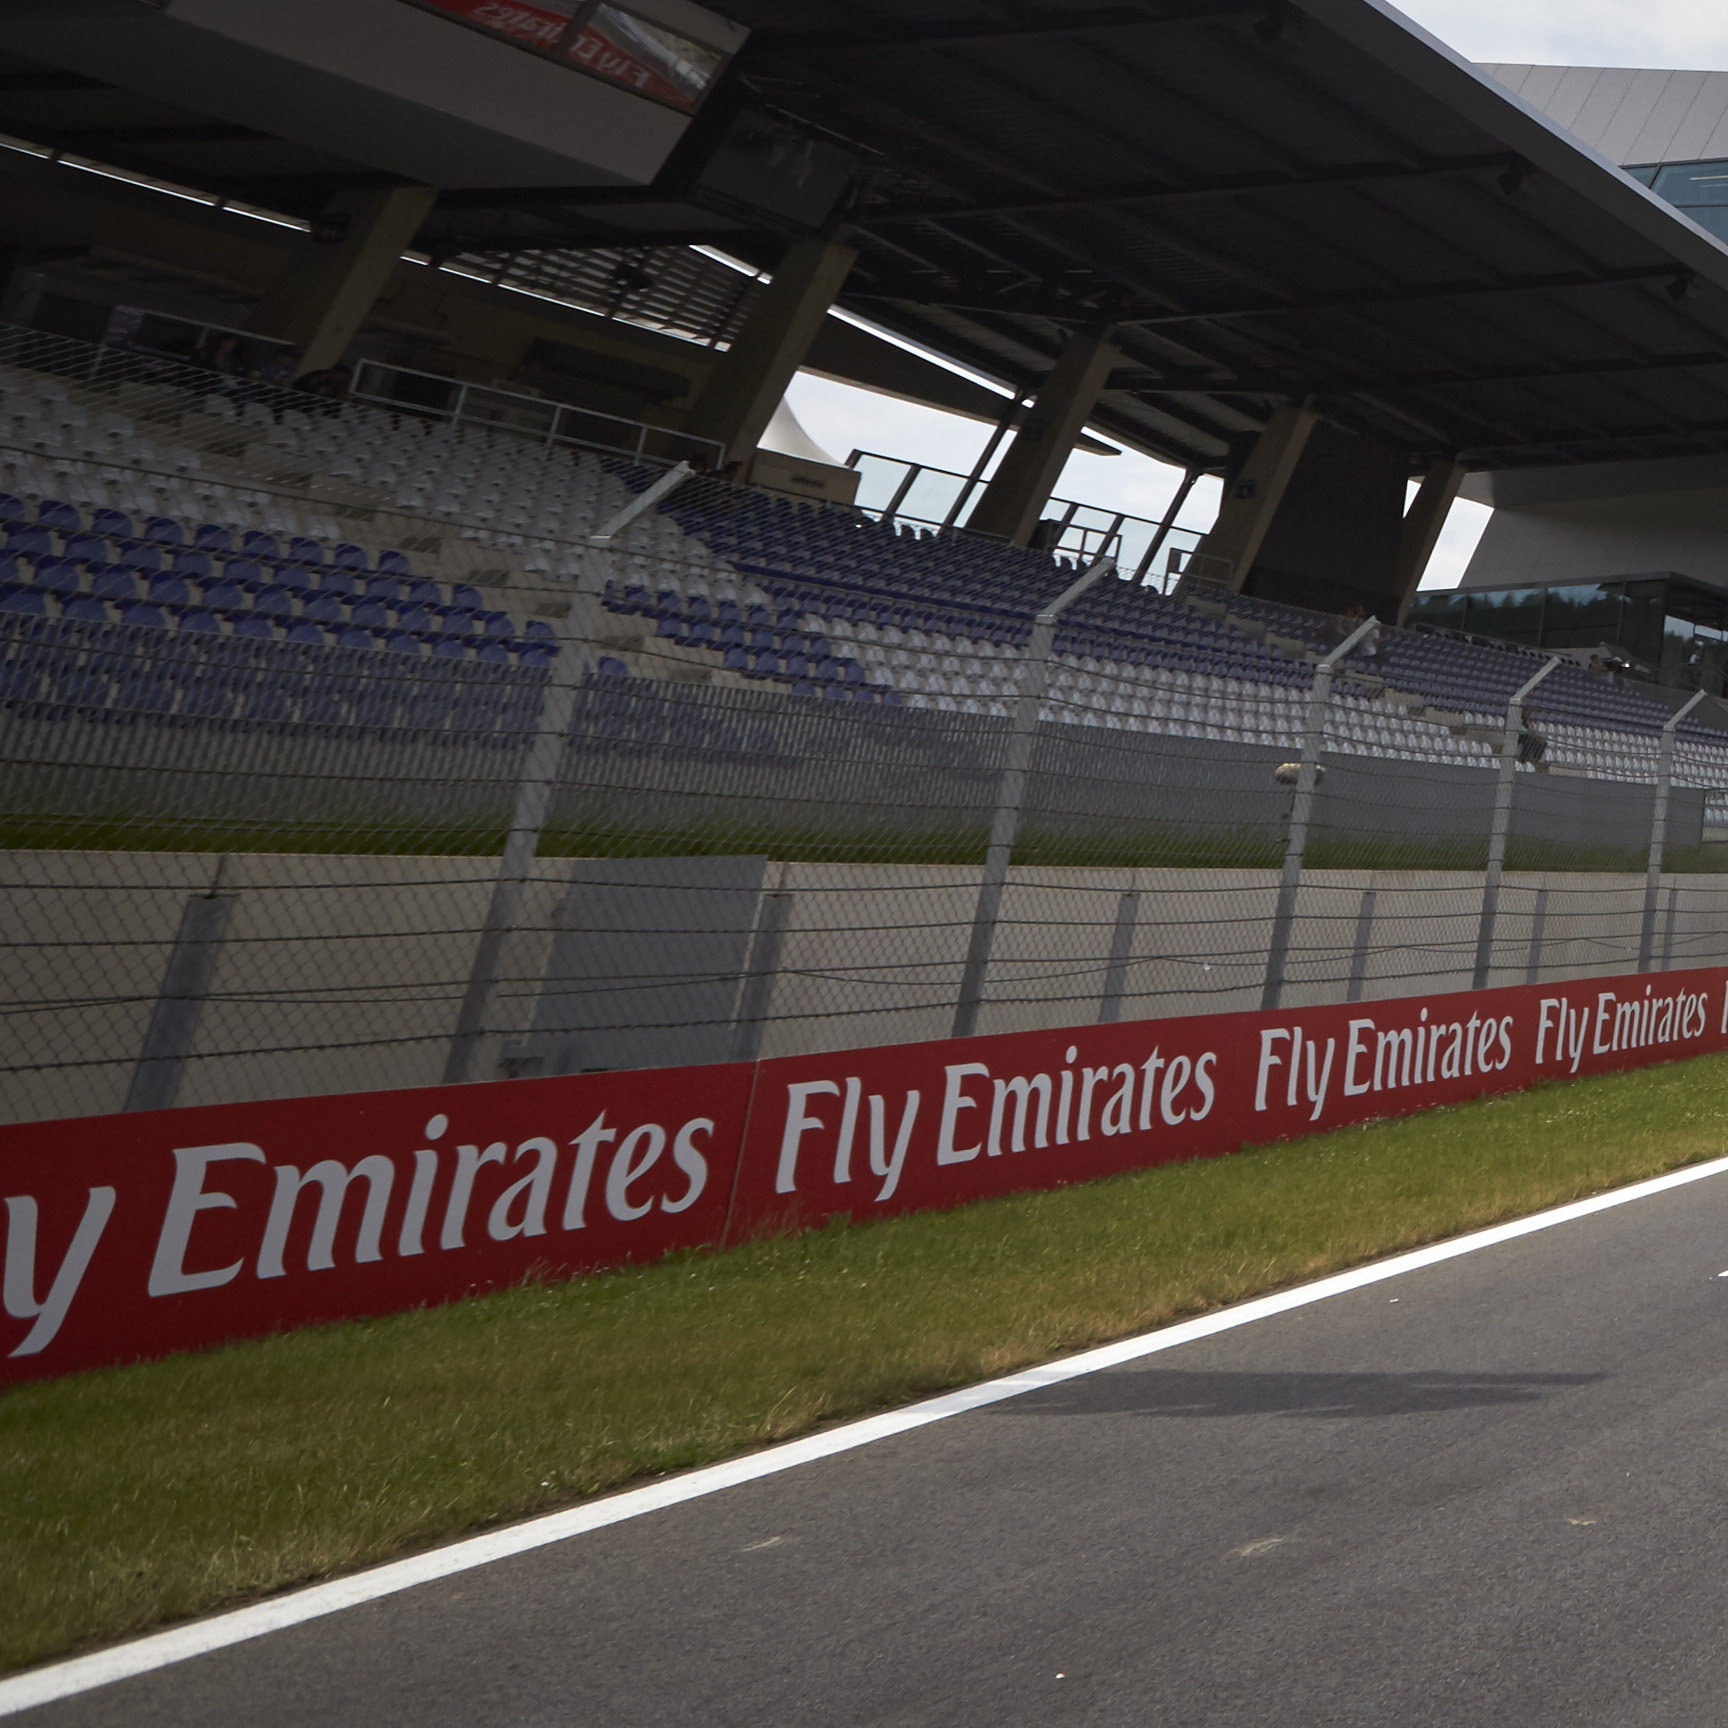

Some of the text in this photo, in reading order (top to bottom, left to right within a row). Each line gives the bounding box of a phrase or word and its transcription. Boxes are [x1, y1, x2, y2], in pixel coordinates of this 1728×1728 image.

[1254, 1007, 1513, 1121] Fly Emirates
[1535, 984, 1708, 1074] Fly Emirates
[775, 1045, 1217, 1202] Fly Emirates
[147, 1112, 716, 1297] Emirates
